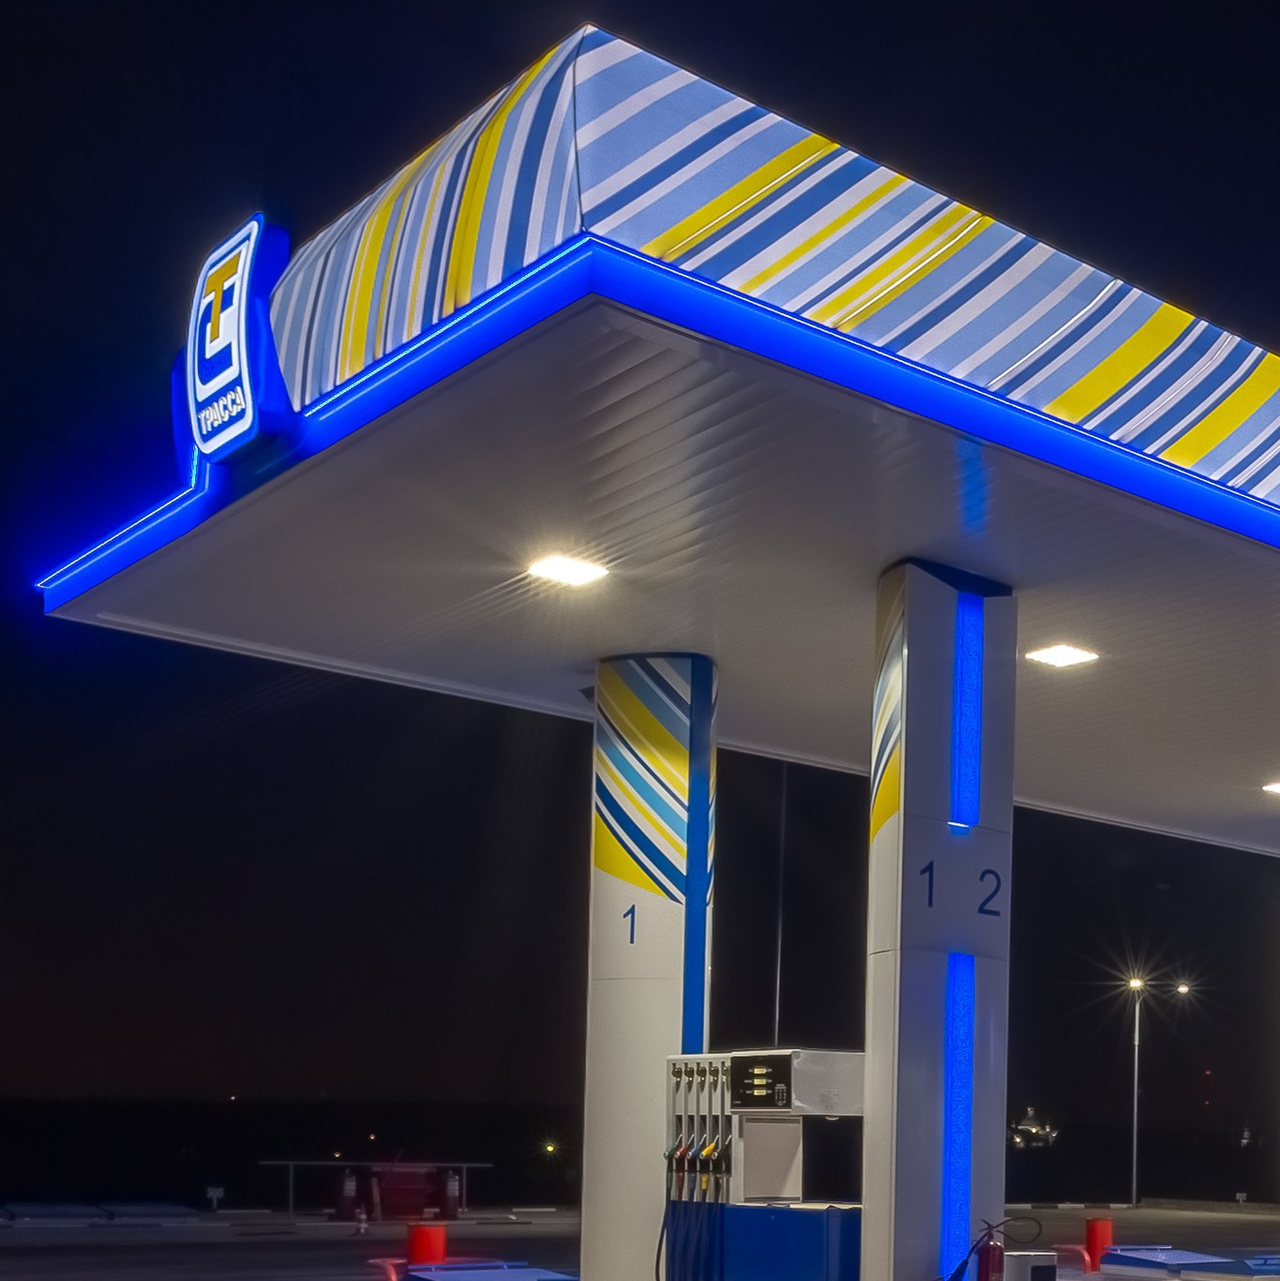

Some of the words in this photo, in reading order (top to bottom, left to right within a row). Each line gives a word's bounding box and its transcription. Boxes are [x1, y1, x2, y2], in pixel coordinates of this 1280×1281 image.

[198, 386, 246, 435] ТРАССА
[920, 860, 934, 908] 1
[977, 868, 1001, 917] 2
[623, 904, 636, 945] 1
